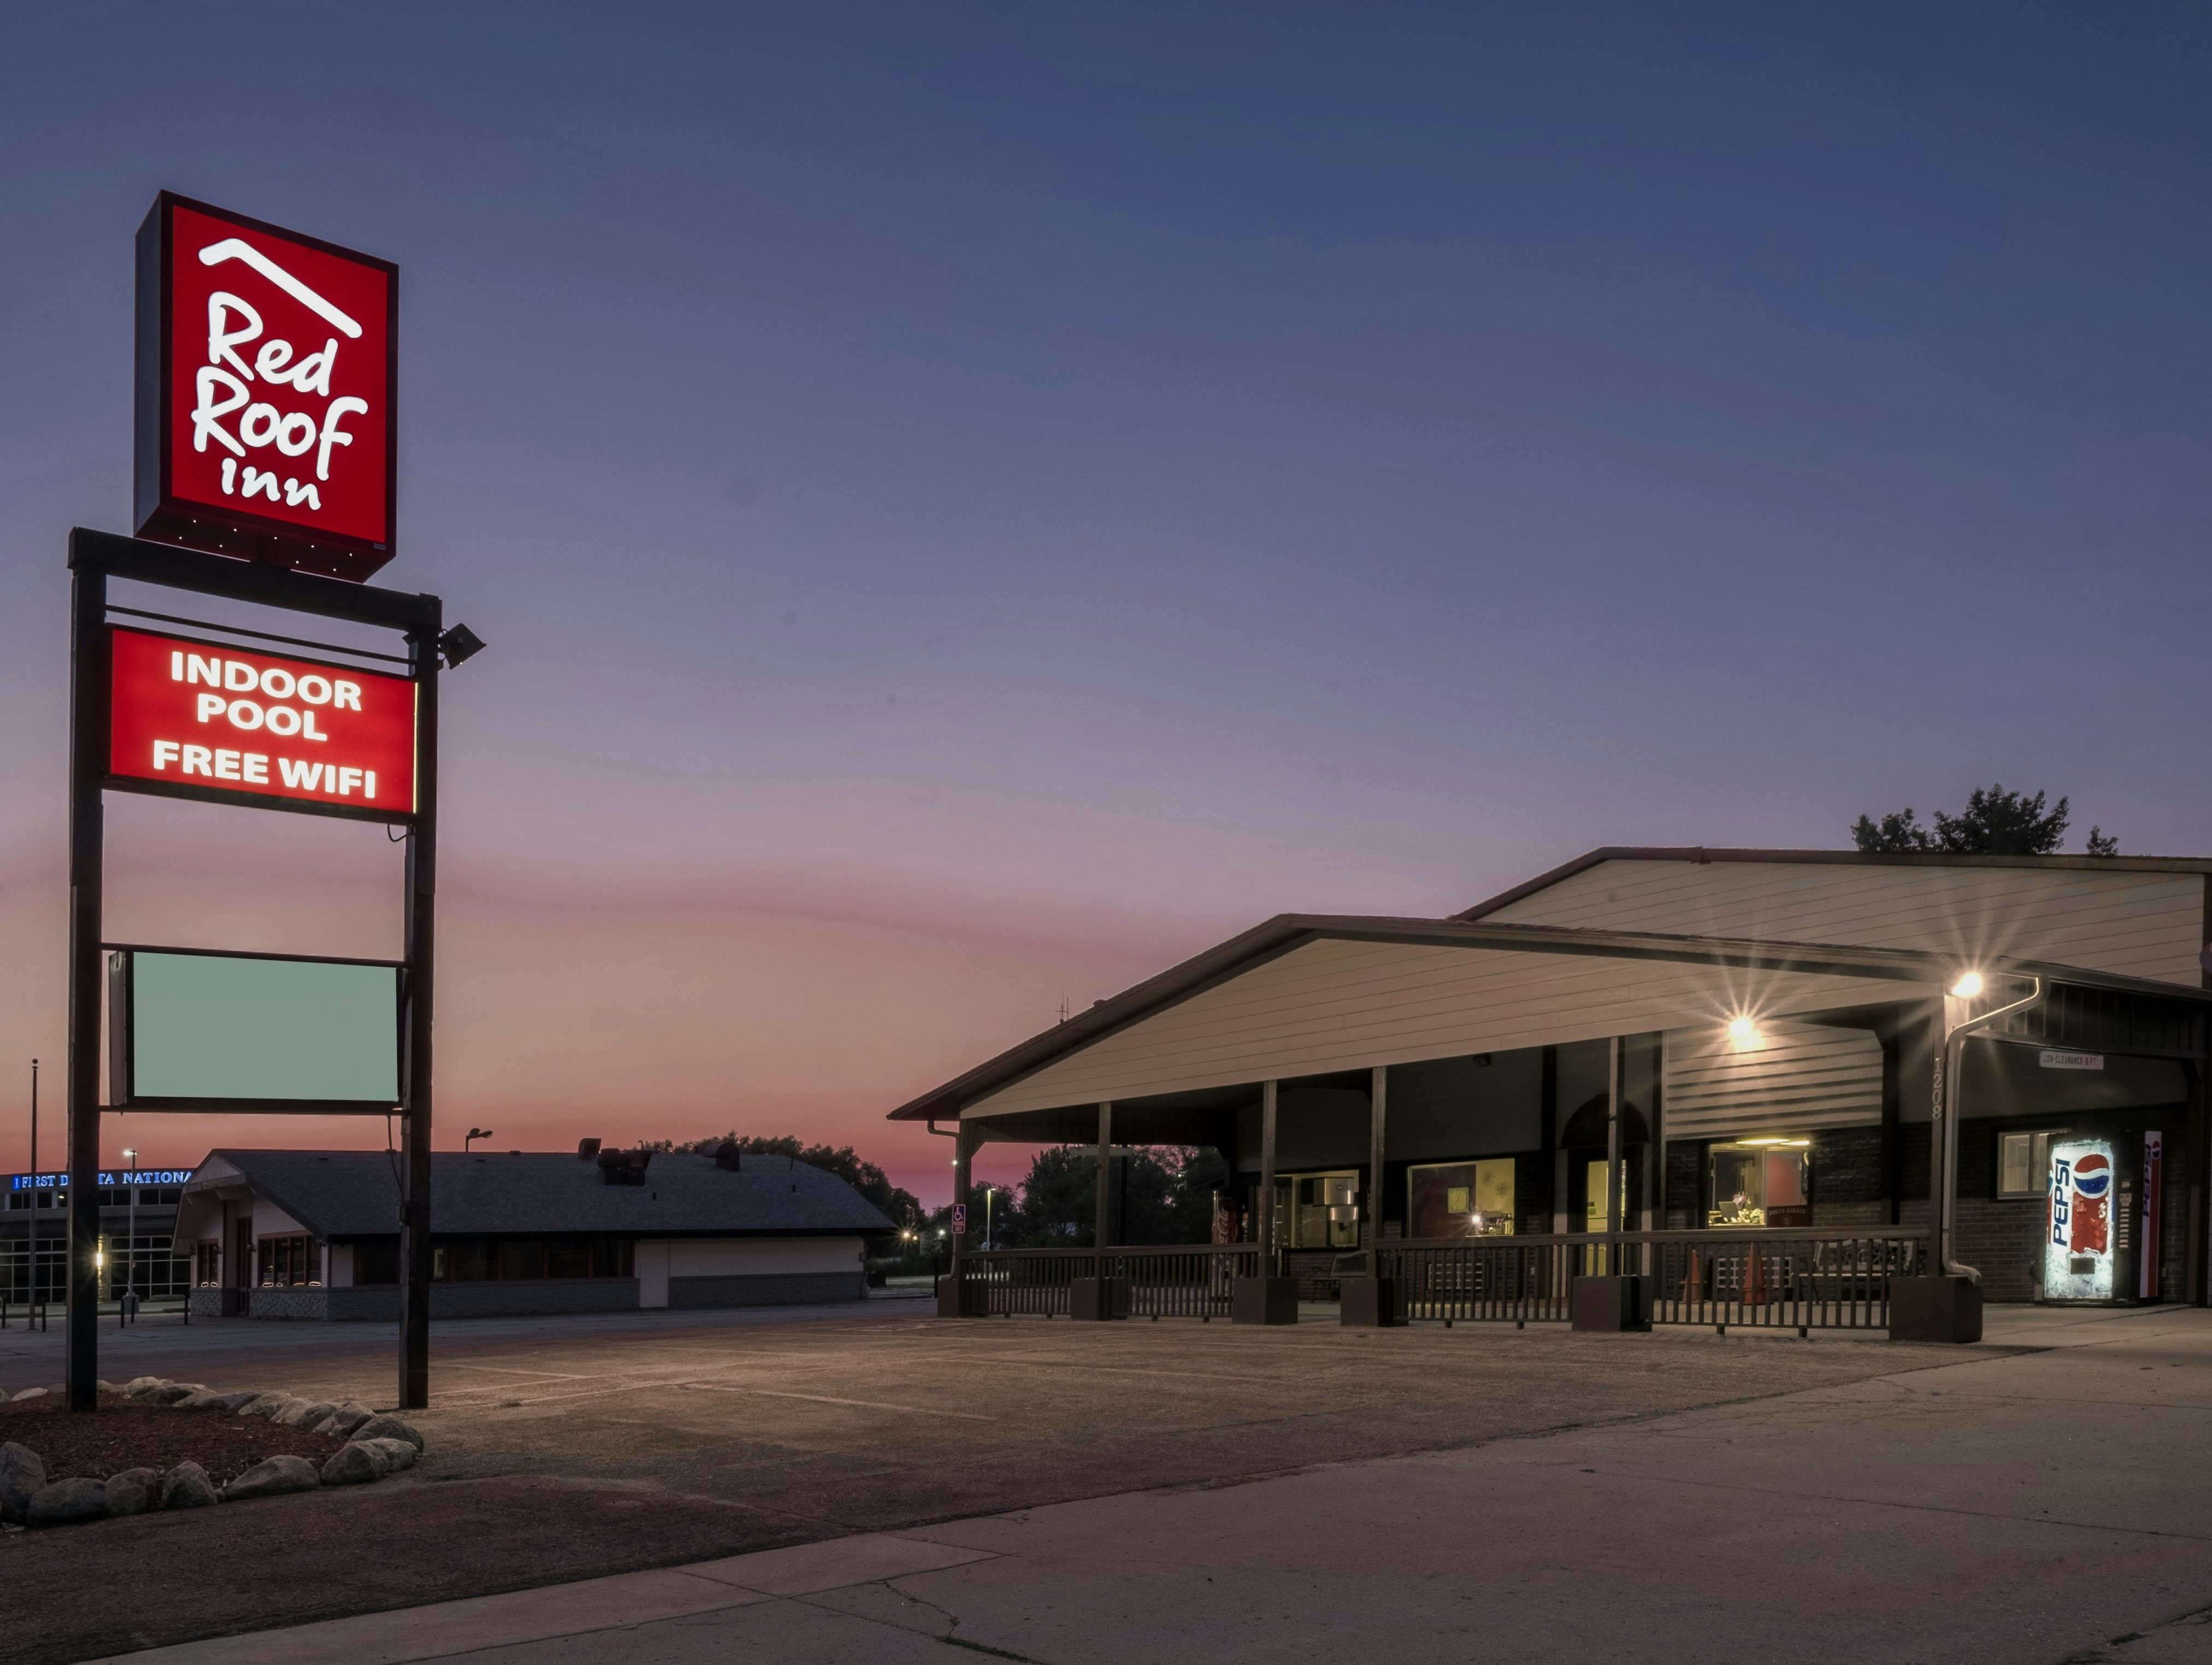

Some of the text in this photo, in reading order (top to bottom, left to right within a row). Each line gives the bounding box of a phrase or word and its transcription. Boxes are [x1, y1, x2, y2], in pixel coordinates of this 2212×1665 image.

[208, 291, 339, 397] Red
[191, 366, 368, 481] Roof
[171, 651, 362, 711] INDOOR
[197, 692, 328, 742] POOL
[153, 739, 376, 799] FREE WIFI
[1932, 1057, 1942, 1120] 1208
[22, 1175, 55, 1187] FIRST
[60, 1173, 115, 1186] DTA
[123, 1172, 192, 1184] NATIONA
[2054, 1158, 2070, 1246] PEPSI
[2143, 1144, 2152, 1217] PEPSI
